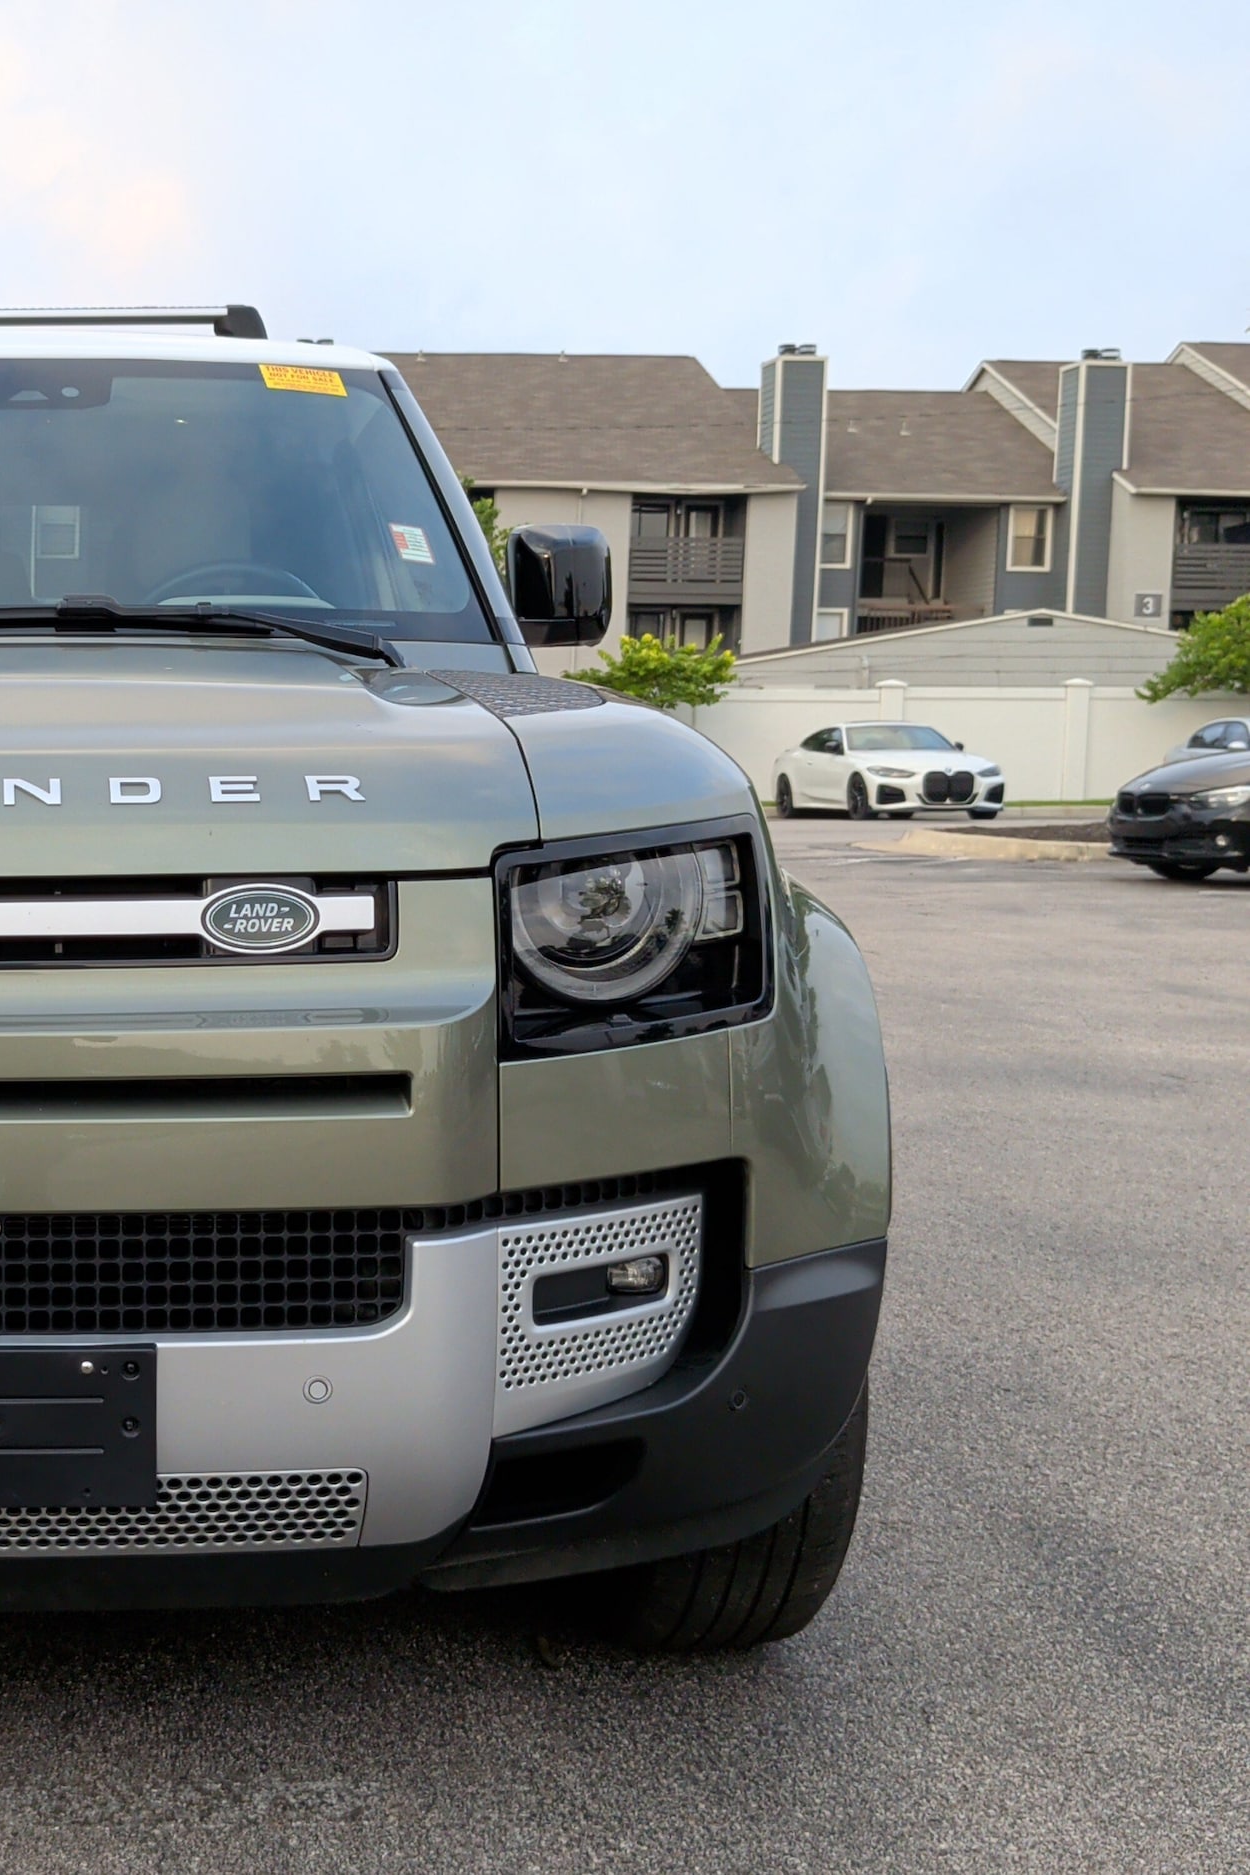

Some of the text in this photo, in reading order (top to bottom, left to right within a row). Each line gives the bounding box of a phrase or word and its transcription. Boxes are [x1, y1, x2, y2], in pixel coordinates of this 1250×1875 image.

[291, 367, 335, 378] VEHICLE
[1142, 597, 1155, 615] 3
[229, 903, 279, 918] LAND
[234, 918, 294, 933] ROVER
